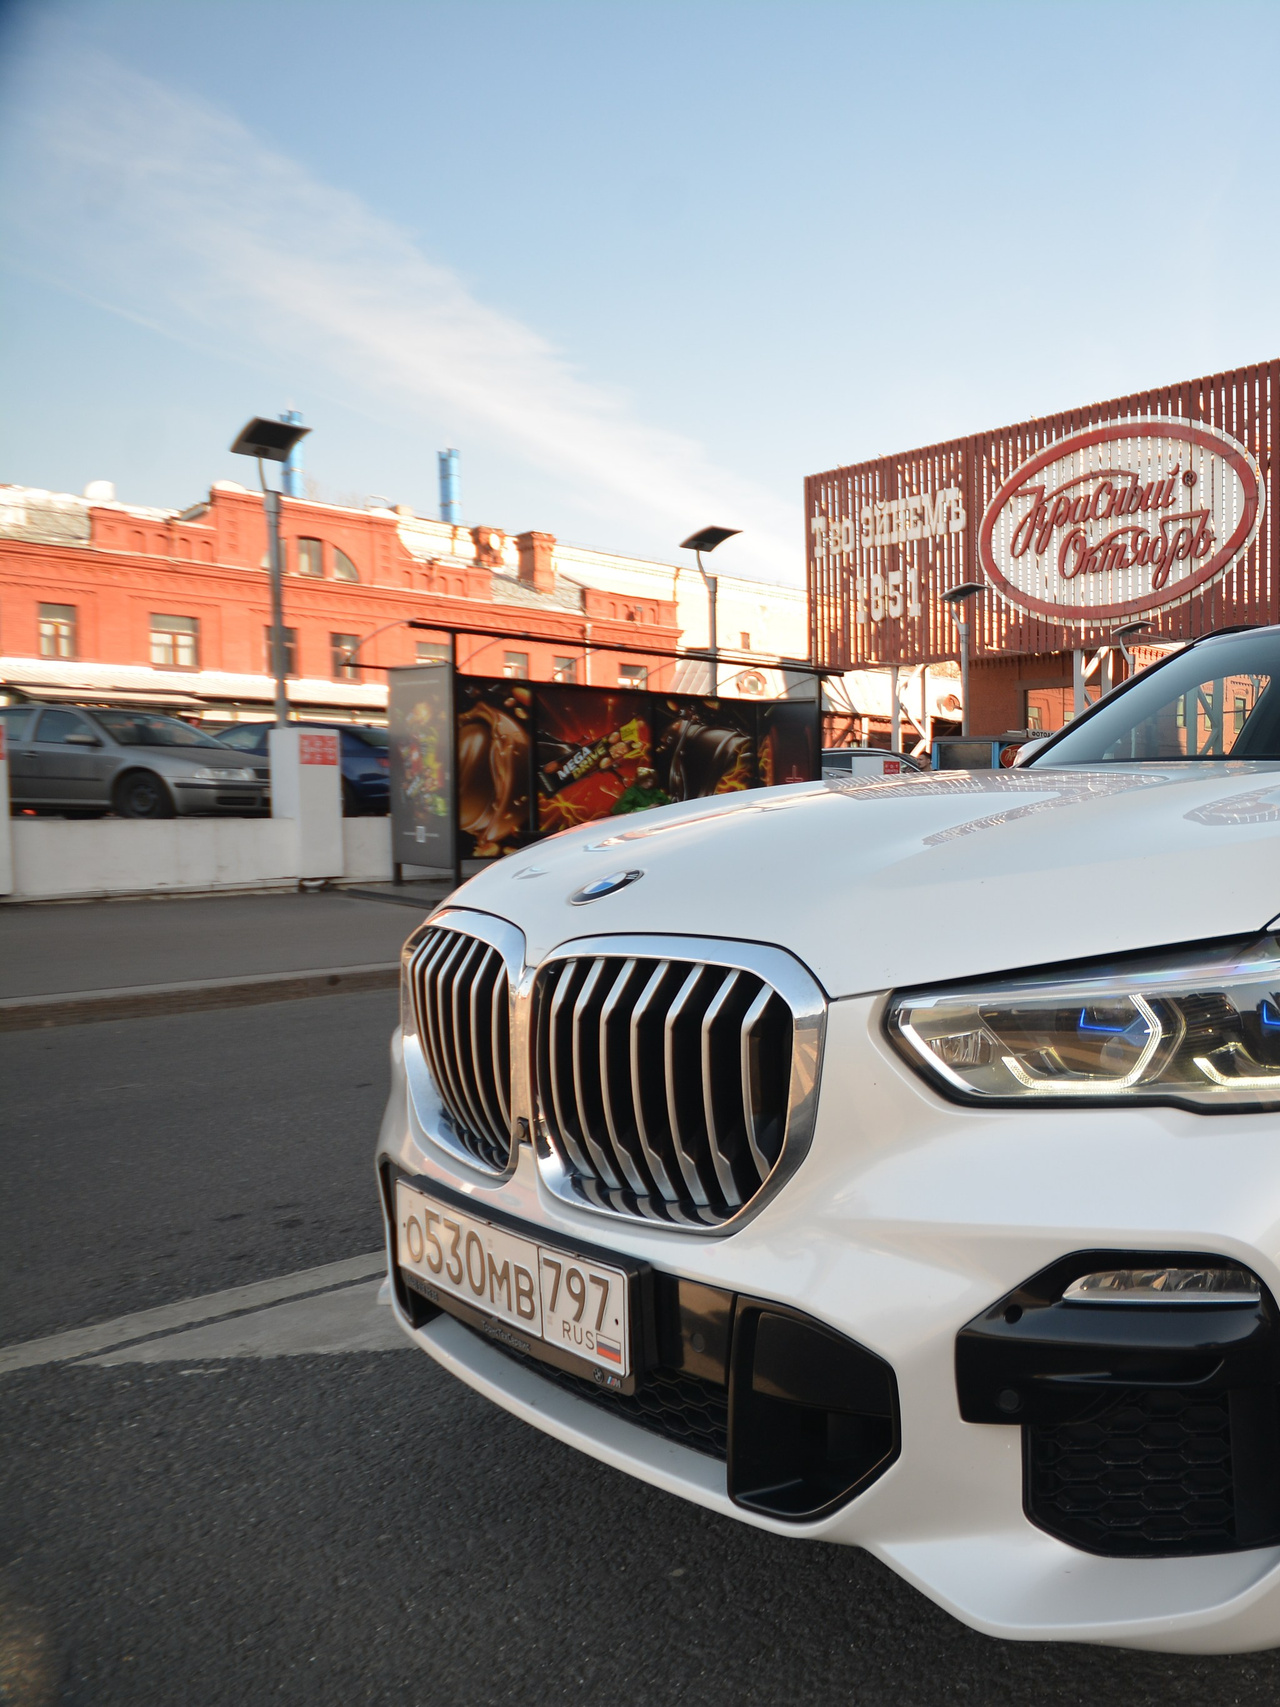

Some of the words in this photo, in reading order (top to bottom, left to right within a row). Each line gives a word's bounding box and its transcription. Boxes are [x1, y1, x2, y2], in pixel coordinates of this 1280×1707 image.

[860, 486, 967, 549] ЭЙНЕМЪ
[1010, 463, 1177, 558] Красный
[1058, 509, 1217, 590] Октябрь
[856, 568, 922, 625] 1851
[556, 746, 592, 781] MEGA
[571, 744, 607, 780] DRIVE
[543, 1257, 610, 1332] 797
[562, 1320, 595, 1350] RUS
